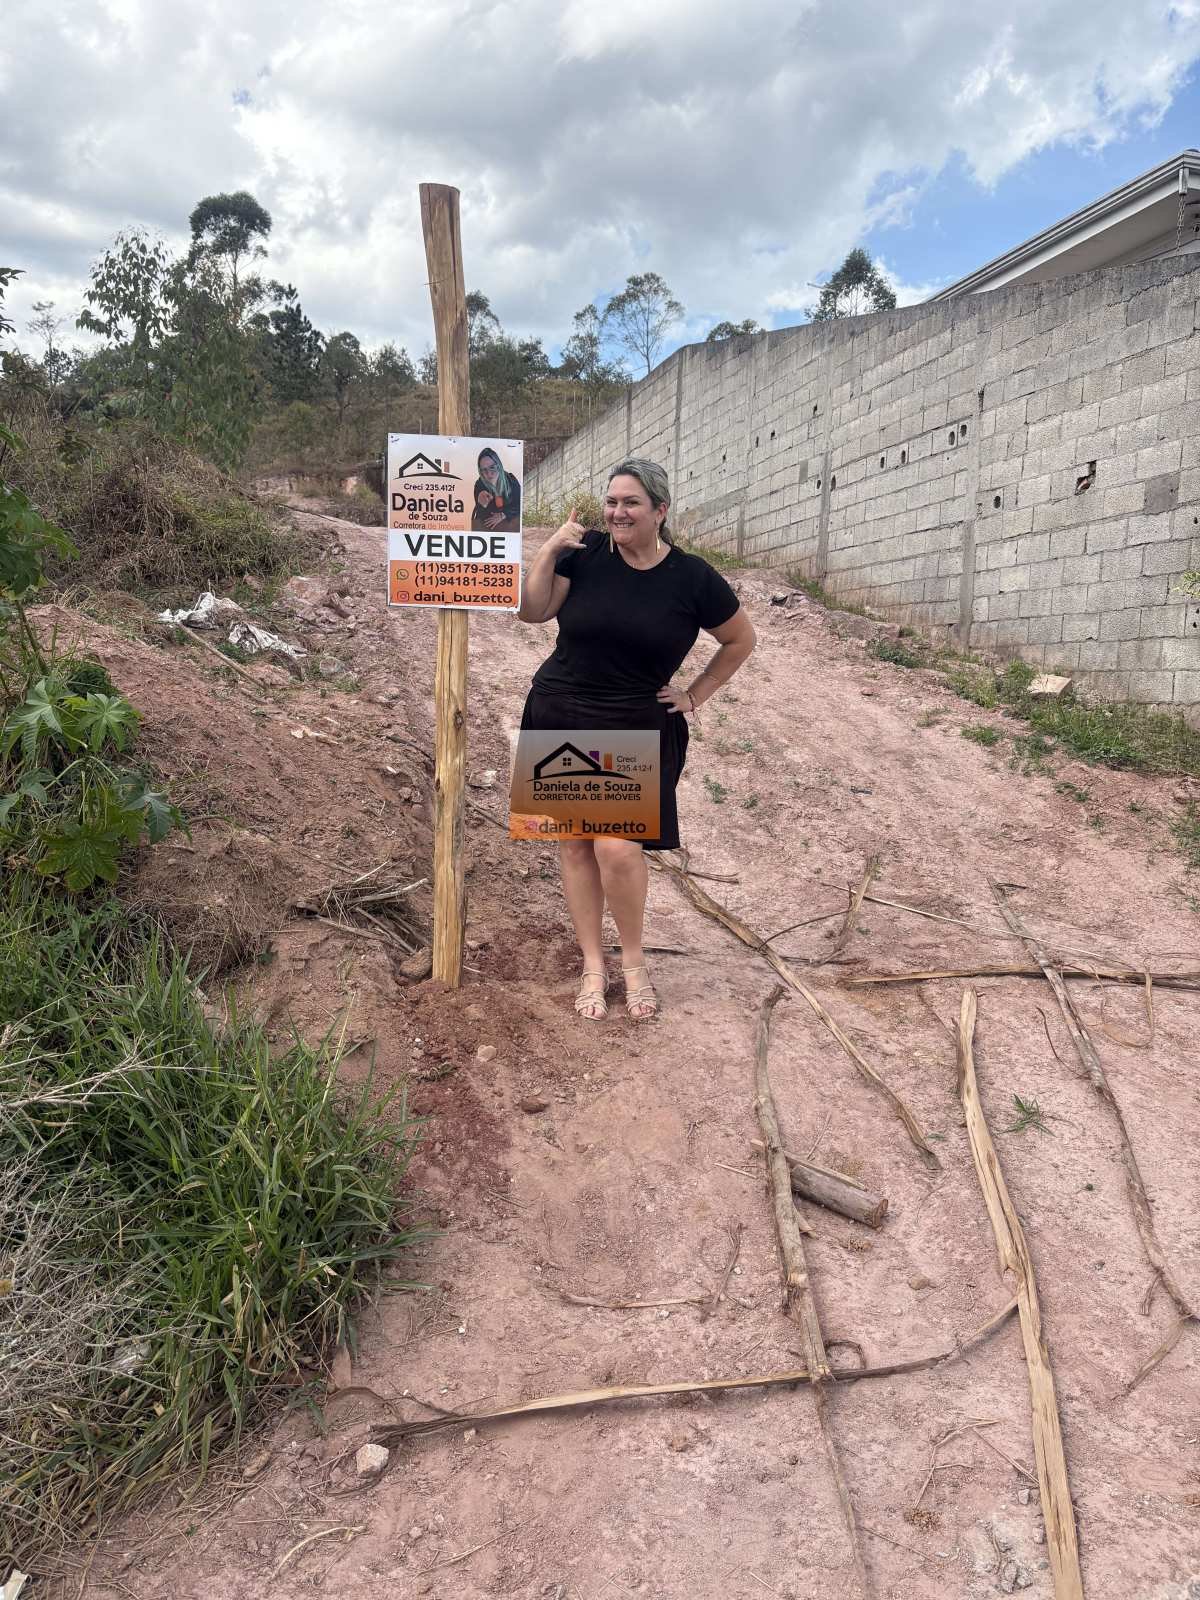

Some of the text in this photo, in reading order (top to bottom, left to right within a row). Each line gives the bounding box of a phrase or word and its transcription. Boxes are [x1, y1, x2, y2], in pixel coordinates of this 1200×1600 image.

[392, 493, 464, 512] Daniela
[408, 512, 448, 521] de Souza
[393, 521, 426, 530] Corretora
[404, 534, 506, 559] VENDE
[415, 562, 514, 575] (11)95179-8383
[415, 575, 513, 588] (11)94181-5238
[414, 591, 513, 604] dani_buzetto
